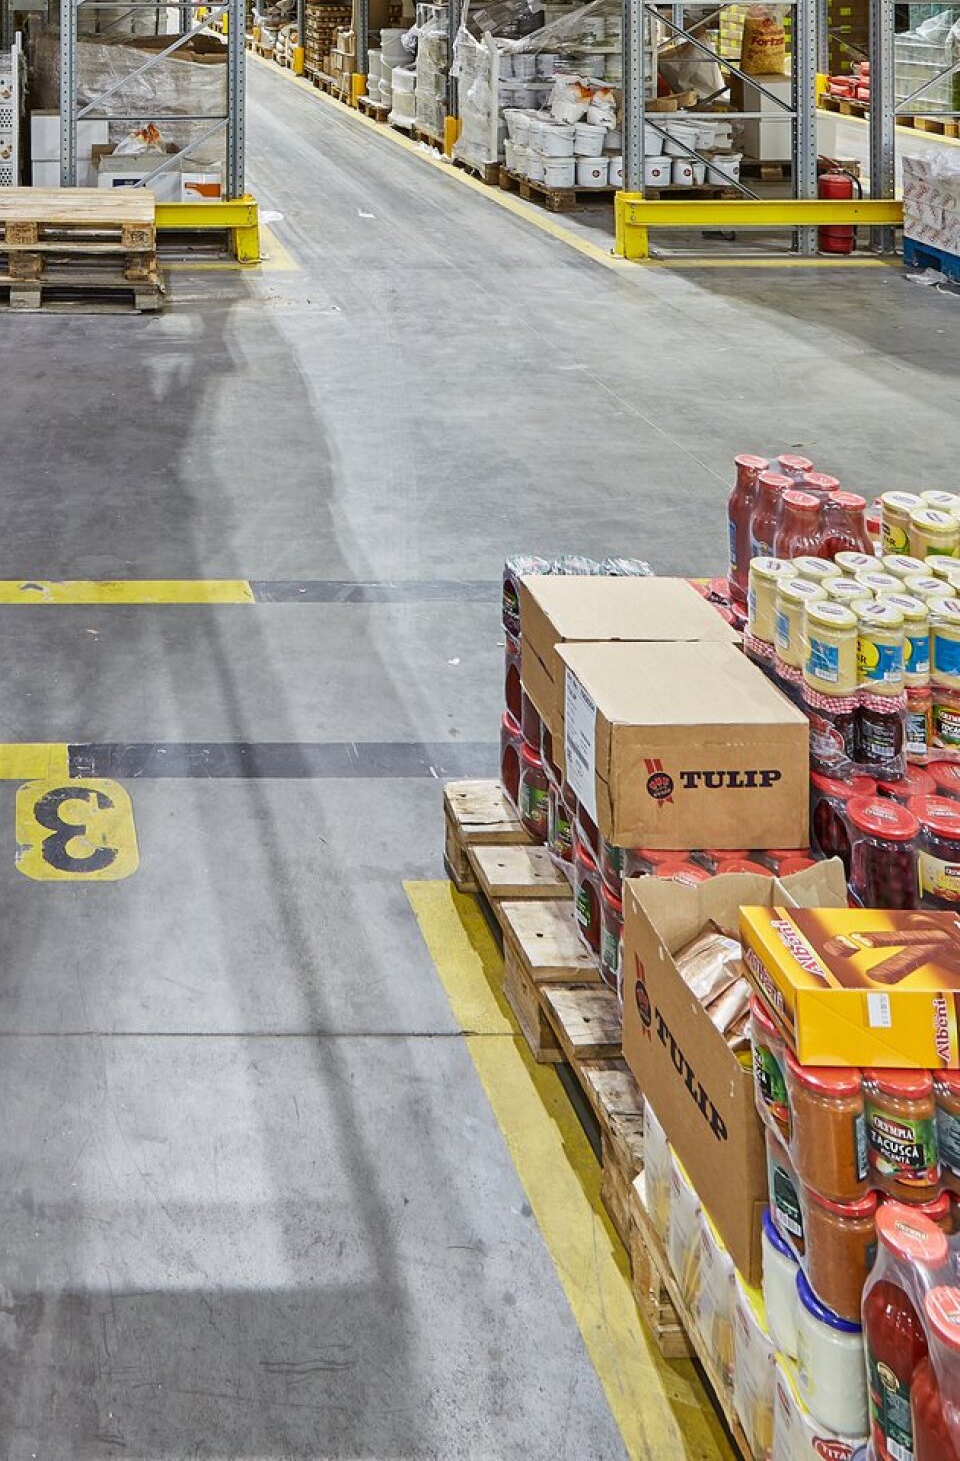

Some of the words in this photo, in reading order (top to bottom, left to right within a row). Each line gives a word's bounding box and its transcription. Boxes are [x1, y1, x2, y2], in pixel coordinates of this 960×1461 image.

[680, 770, 782, 788] TULIP
[34, 787, 118, 872] 3
[655, 1006, 728, 1142] TULIP
